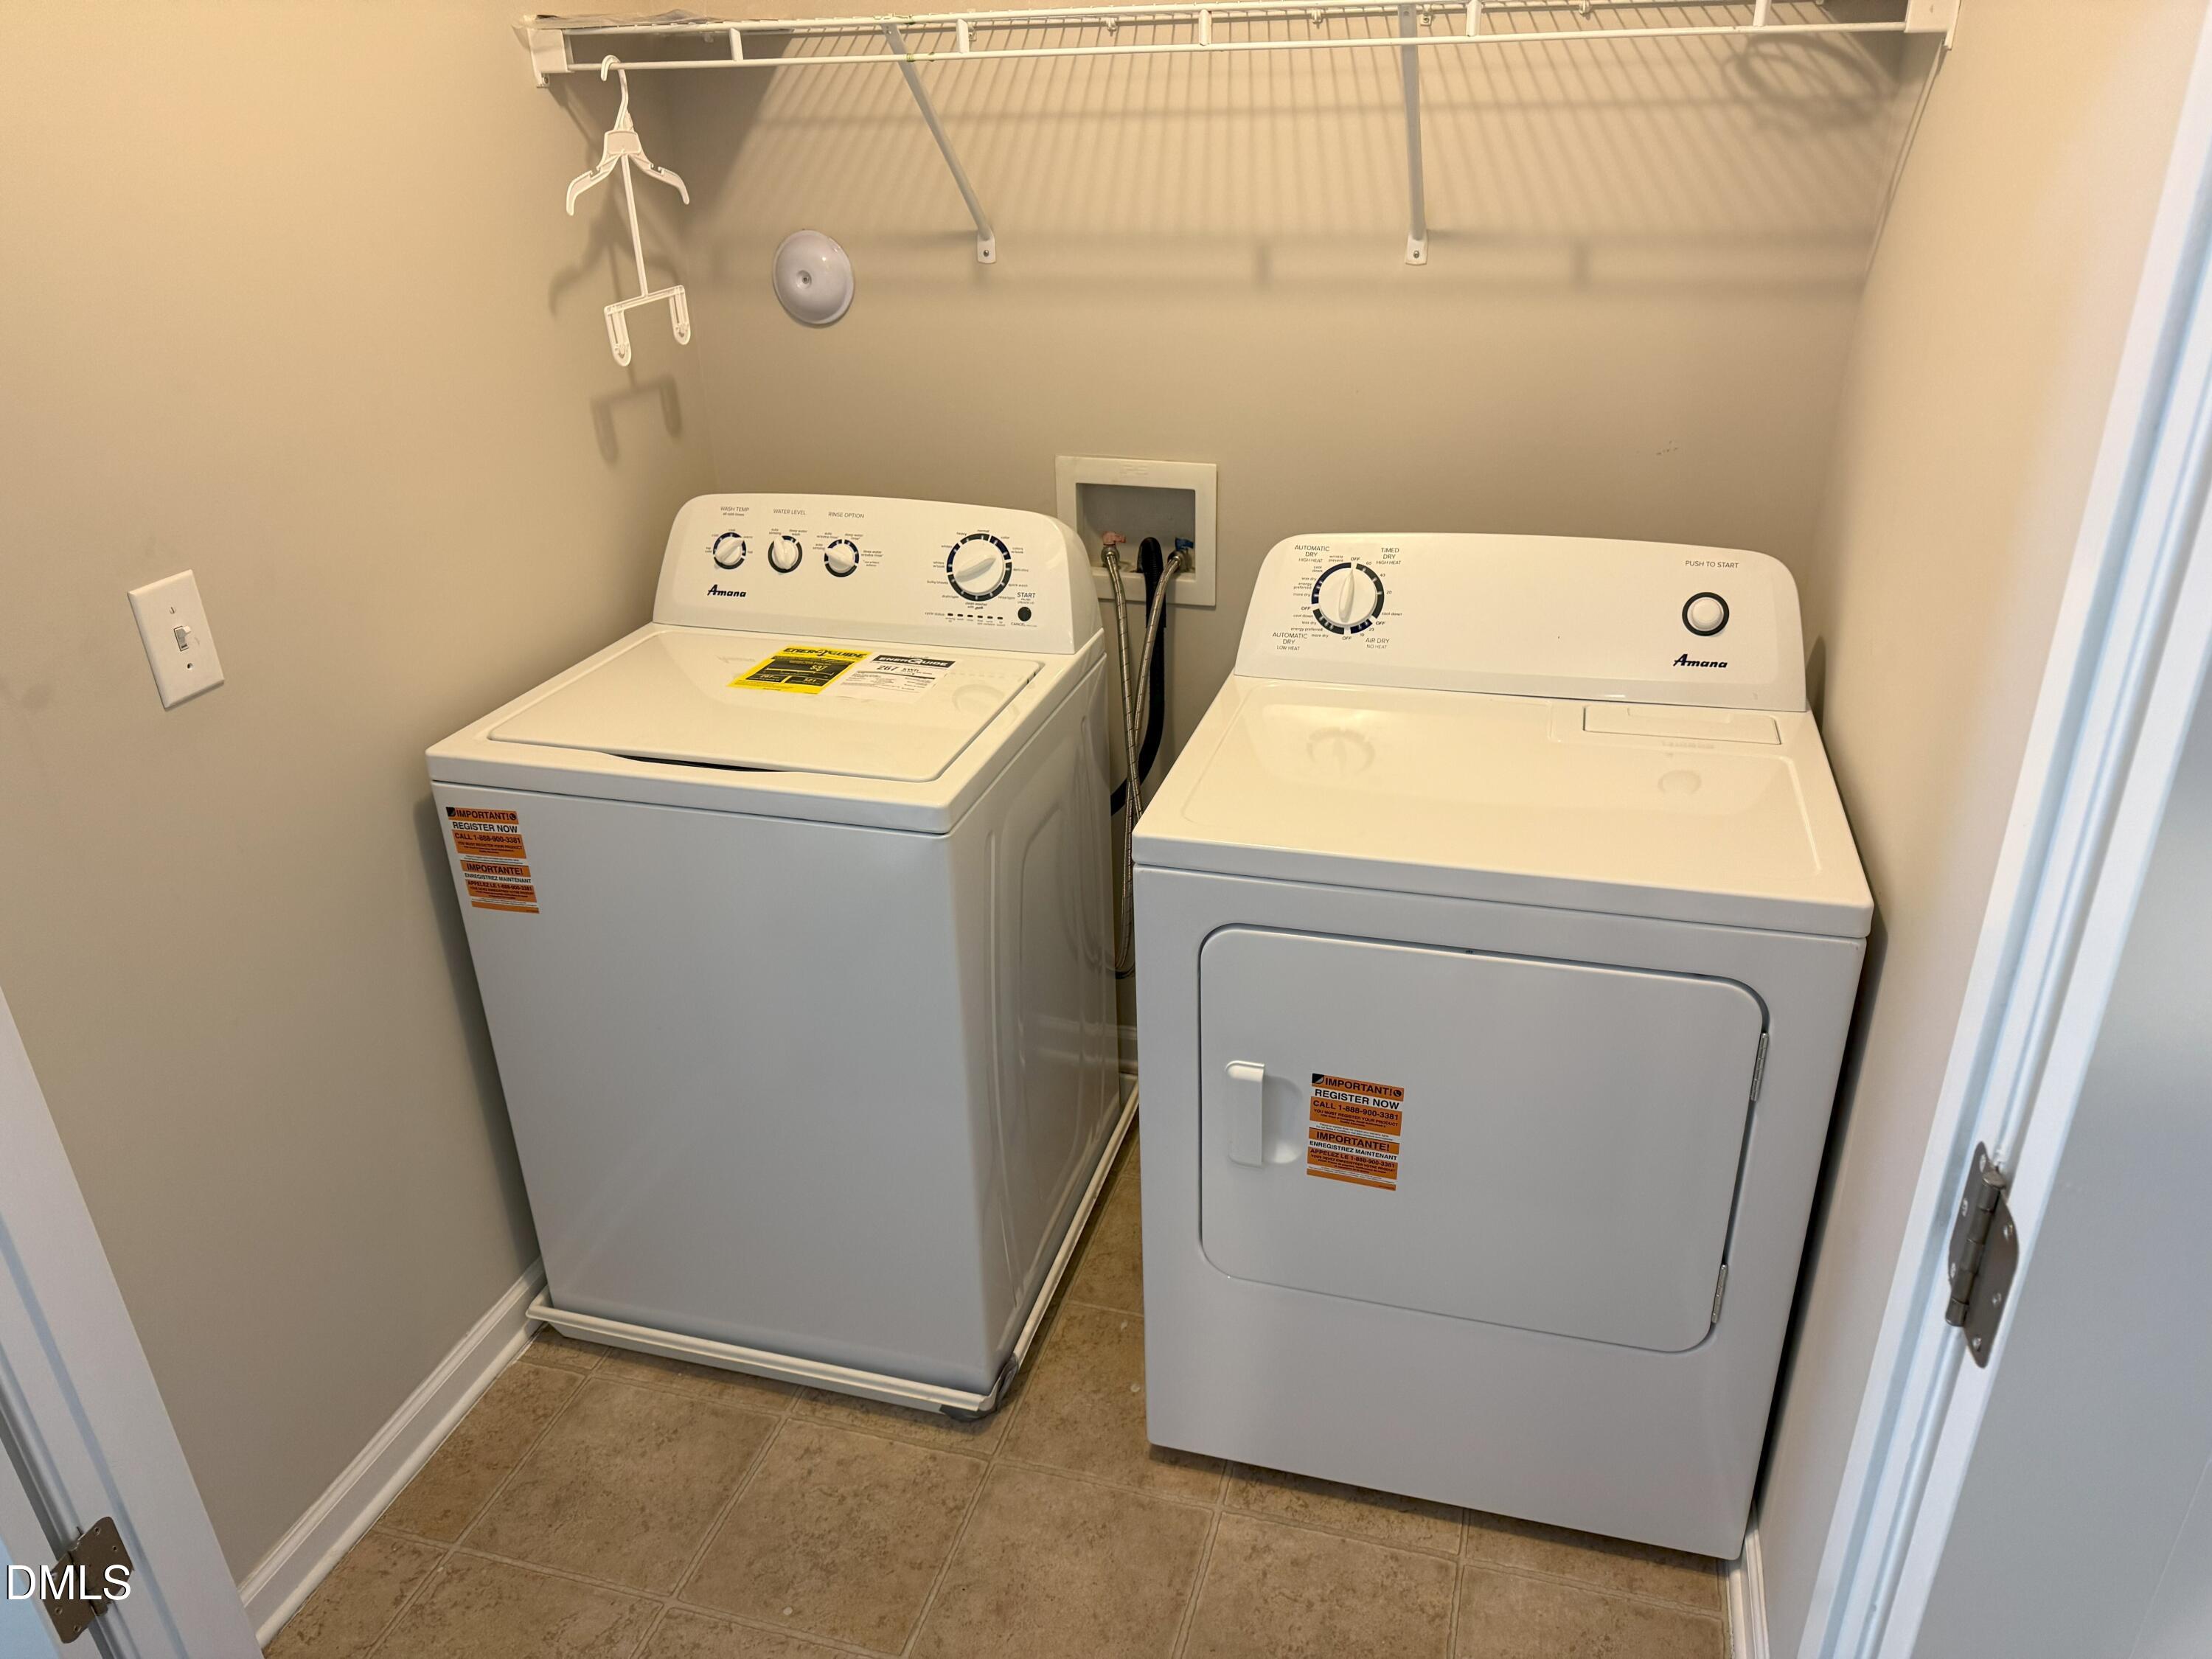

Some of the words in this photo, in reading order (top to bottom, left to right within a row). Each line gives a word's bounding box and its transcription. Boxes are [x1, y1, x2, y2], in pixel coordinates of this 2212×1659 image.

[707, 584, 746, 598] Amana
[1673, 653, 1728, 668] Amana
[456, 810, 509, 821] IMPORTANT!
[452, 821, 495, 832] REGISTER
[496, 824, 518, 833] NOW
[454, 832, 472, 841] CALL
[467, 863, 524, 875] IMPORTANTE!
[465, 872, 498, 881] ENREGISTREZ
[1325, 1077, 1393, 1096] IMPORTANT!
[1315, 1088, 1369, 1105] REGISTER
[1372, 1099, 1399, 1110] NOW
[1313, 1100, 1336, 1110] CALL
[1338, 1105, 1399, 1121] 1-888-900-3381
[1338, 1112, 1361, 1120] REGISTER
[1316, 1131, 1390, 1152] IMPORTANTE!
[1309, 1140, 1354, 1153] ENREGISTREZ
[1355, 1149, 1397, 1161] MAINTENANT
[1310, 1149, 1340, 1158] APPELEZ
